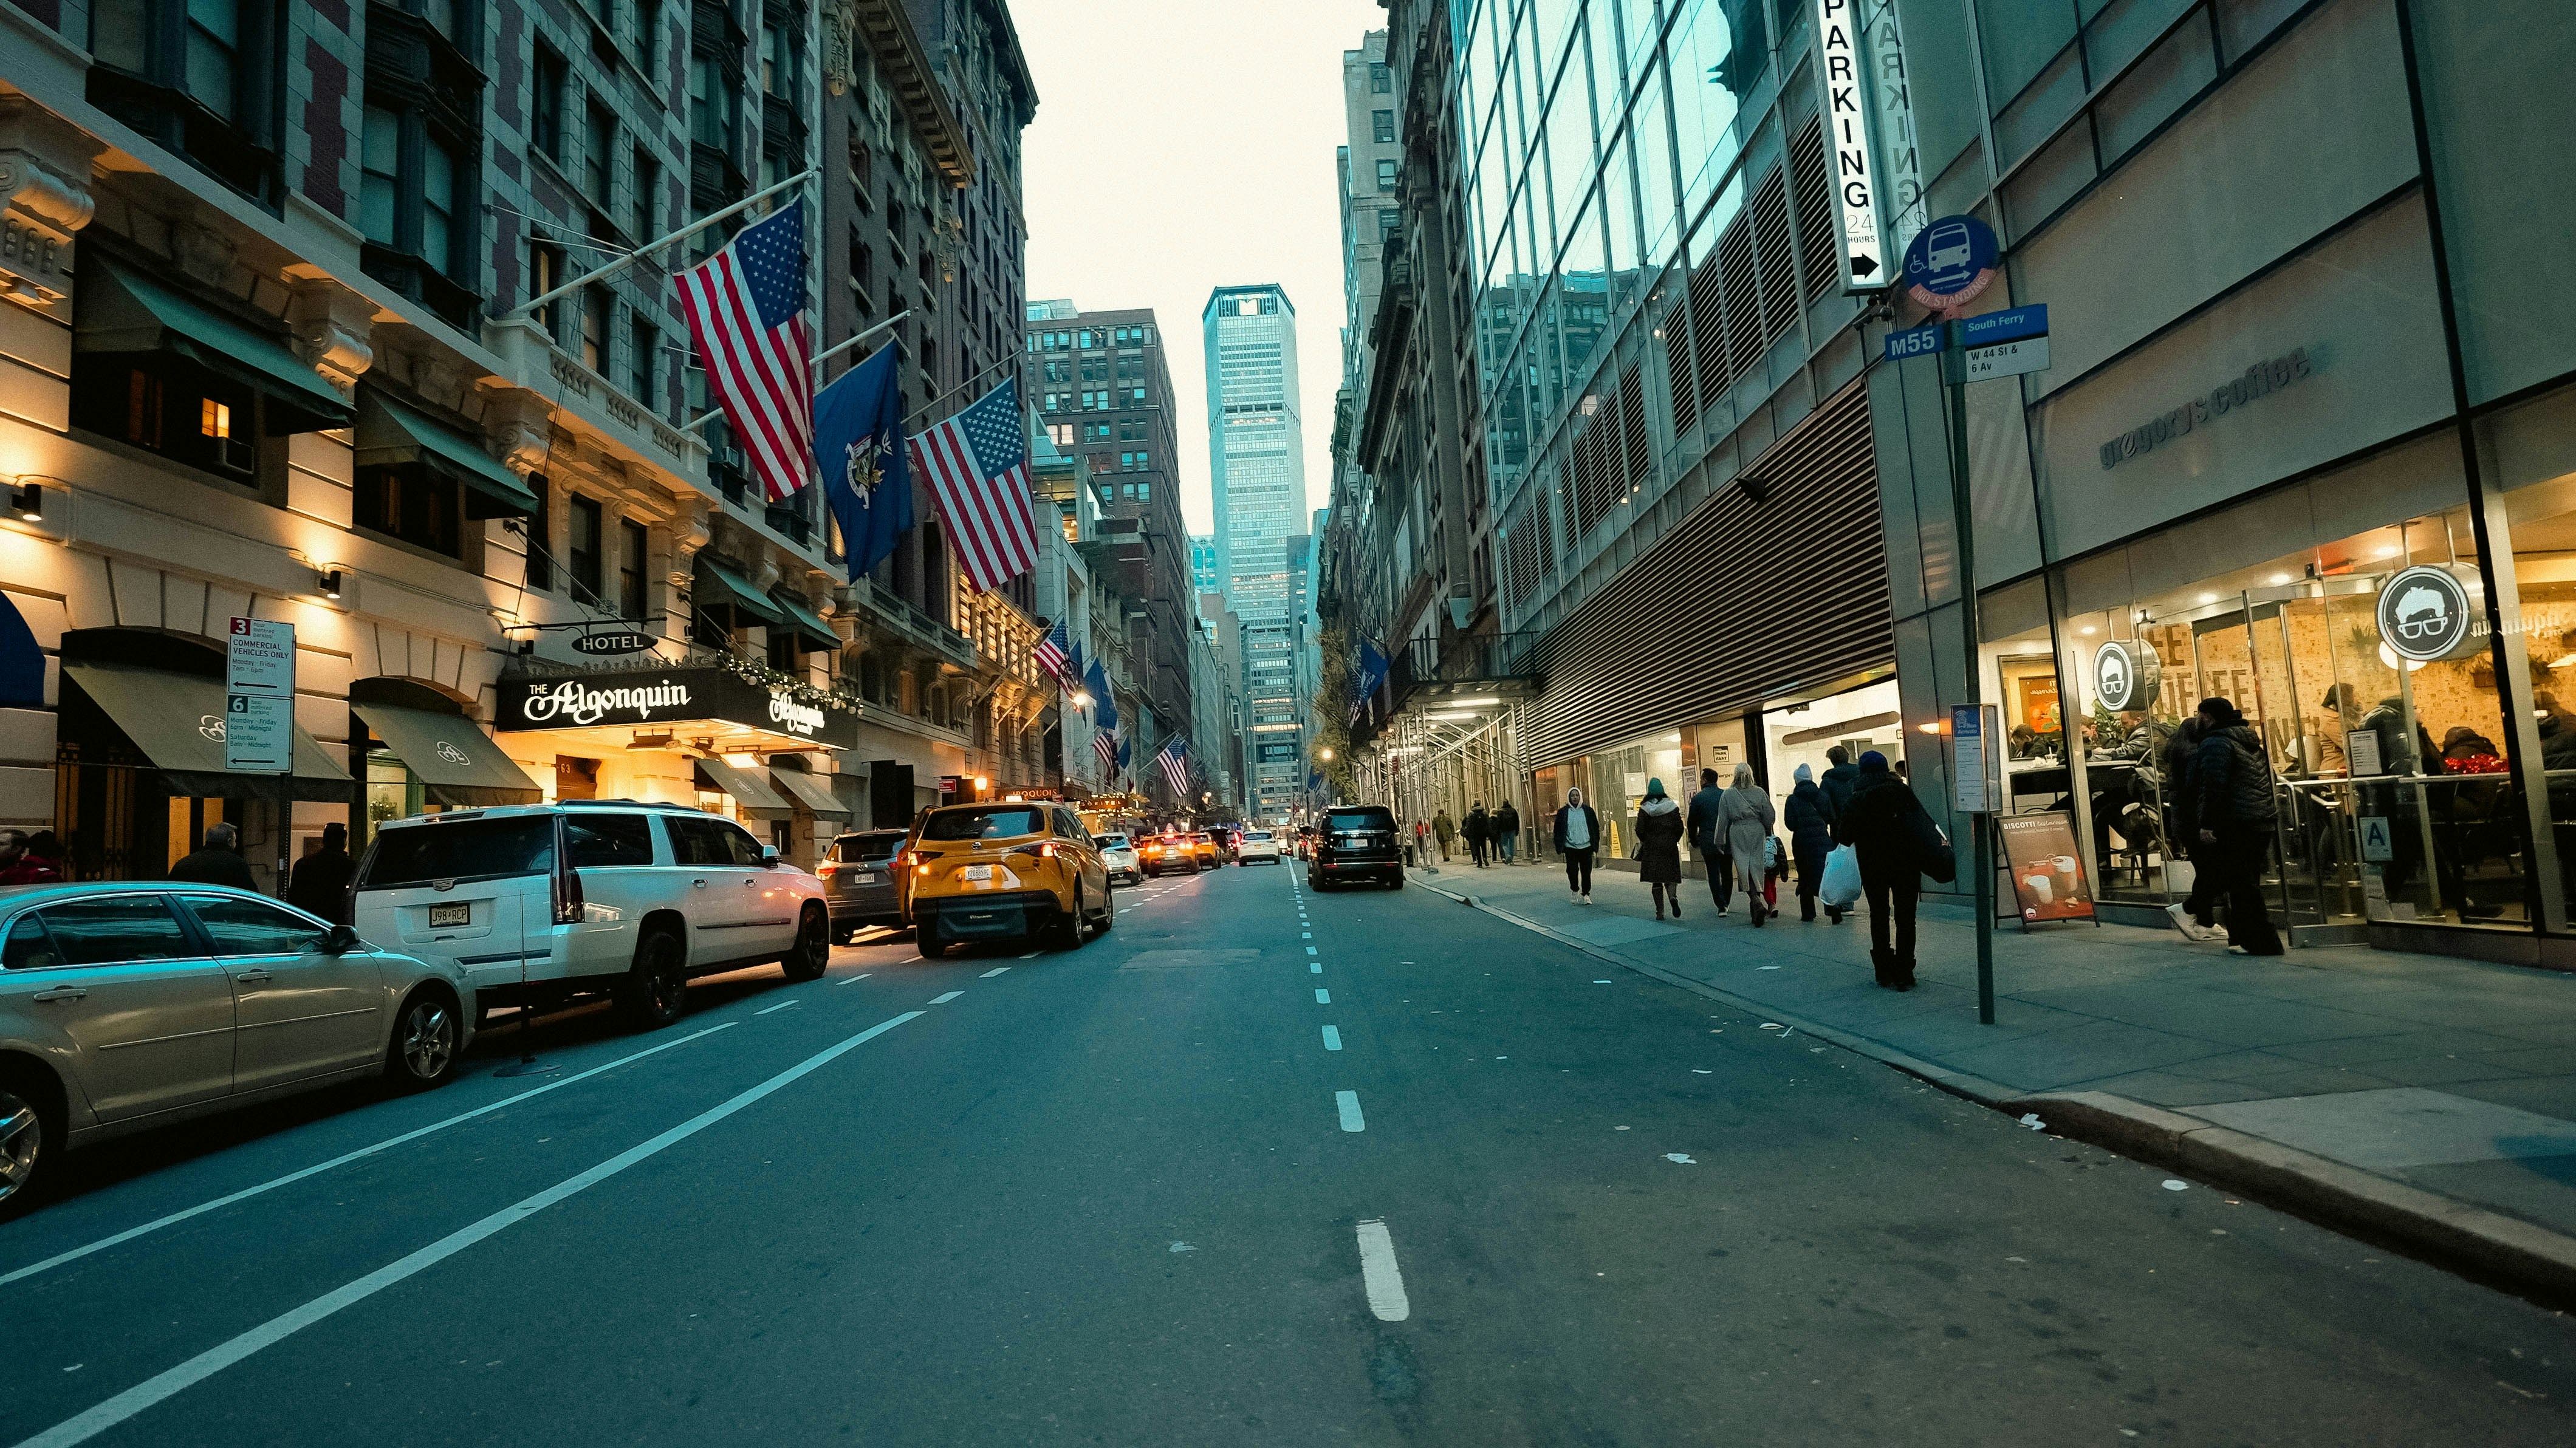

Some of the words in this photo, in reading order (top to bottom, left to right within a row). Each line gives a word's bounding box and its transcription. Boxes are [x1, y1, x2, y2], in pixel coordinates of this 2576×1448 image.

[1824, 0, 1869, 207] PARKING
[1846, 214, 1874, 233] 24
[1848, 235, 1875, 244] HOURS
[1916, 290, 1930, 304] NO
[1933, 276, 1989, 307] STANDING
[1968, 319, 1996, 332] South
[1999, 314, 2024, 327] Ferry
[1891, 329, 1935, 357] M55
[1971, 351, 1980, 361] W
[1983, 349, 1995, 358] 44
[2012, 344, 2018, 353] &
[1971, 364, 1977, 373] 6
[1981, 362, 1992, 372] Av
[236, 619, 246, 634] 3
[233, 639, 281, 650] COMMERCIAL
[583, 635, 645, 651] HOTEL
[233, 647, 269, 657] VEHICLES
[270, 651, 289, 660] ONLY
[529, 684, 547, 695] THE
[233, 697, 244, 712] 6
[524, 679, 692, 725] Algonquin
[1013, 788, 1058, 798] IROQUOIS
[2003, 821, 2036, 830] BISCOTTI
[2367, 822, 2386, 847] A
[433, 910, 447, 921] J98
[452, 909, 467, 920] RCP
